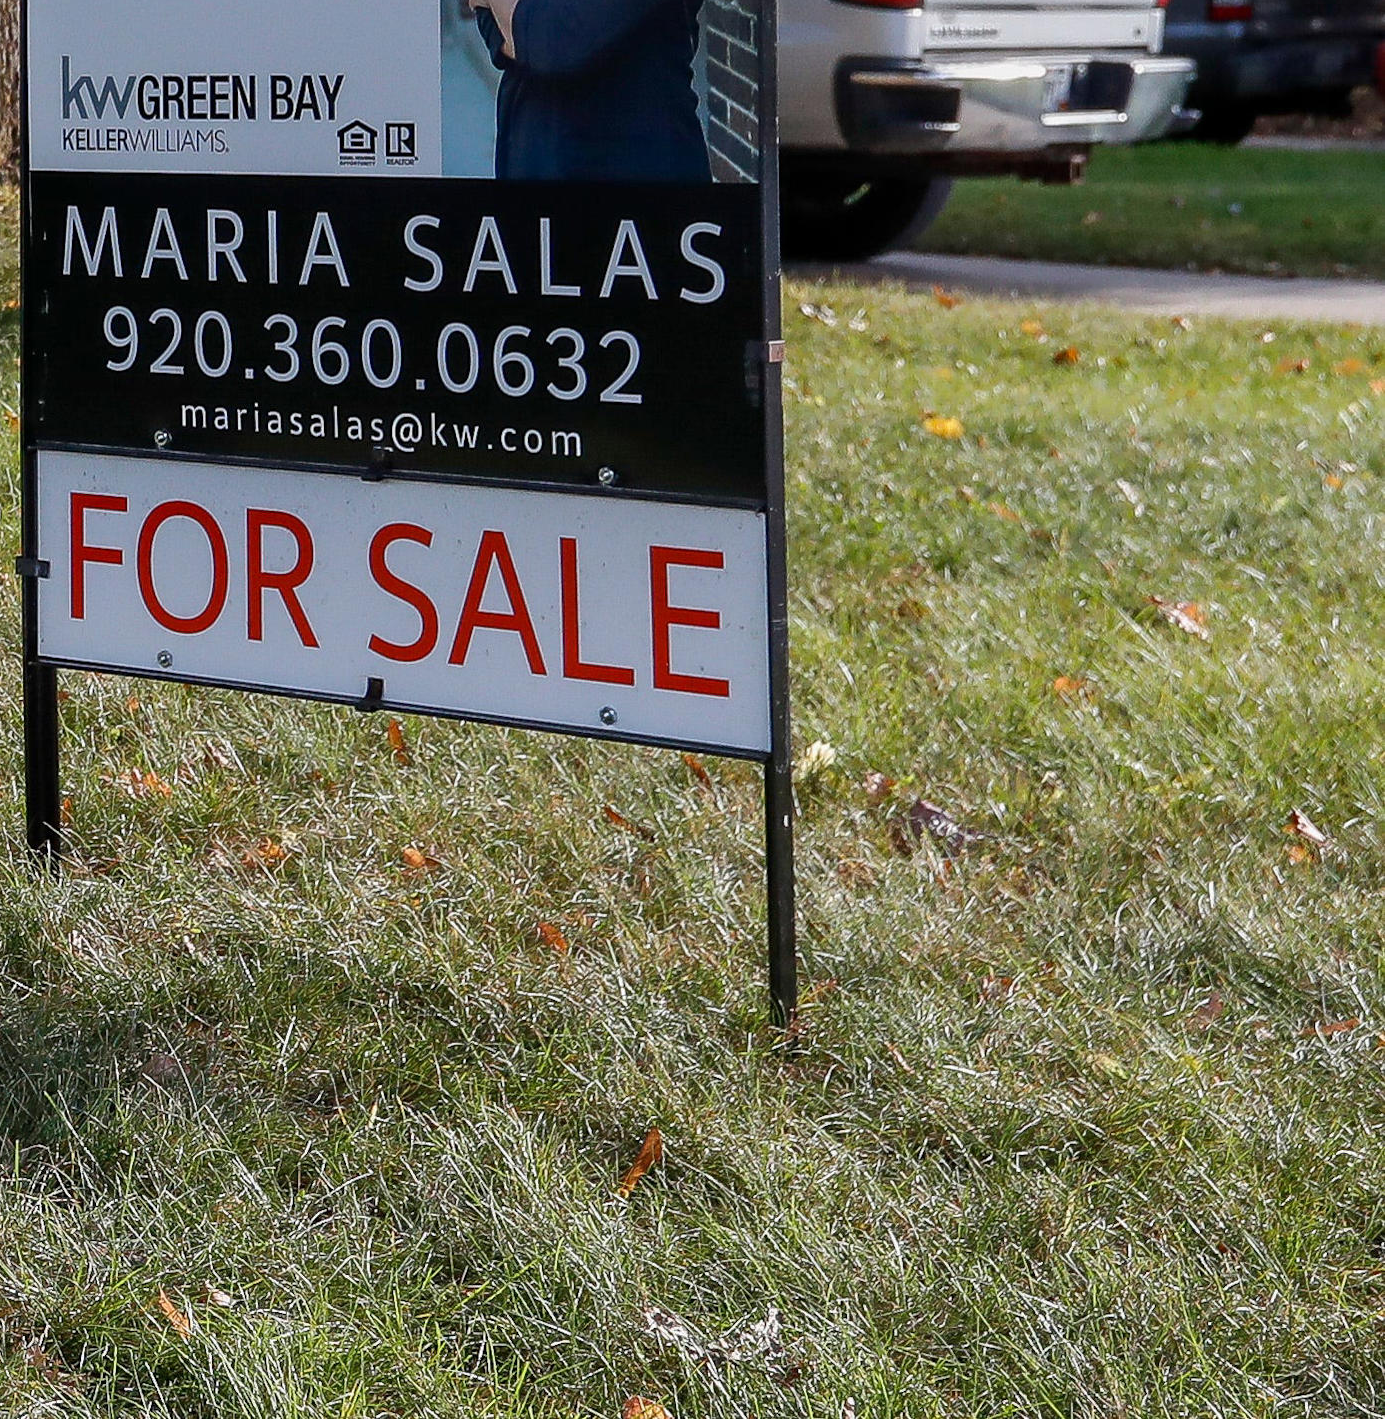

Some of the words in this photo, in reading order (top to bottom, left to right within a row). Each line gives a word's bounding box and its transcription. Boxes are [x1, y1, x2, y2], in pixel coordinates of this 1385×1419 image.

[269, 74, 345, 121] BAY
[62, 205, 351, 288] MARIA
[403, 214, 726, 304] SALAS
[102, 306, 644, 406] 920.360.0632
[180, 400, 583, 458] mariasalas@kw.com
[69, 491, 321, 650] FOR
[367, 522, 731, 699] SALE
